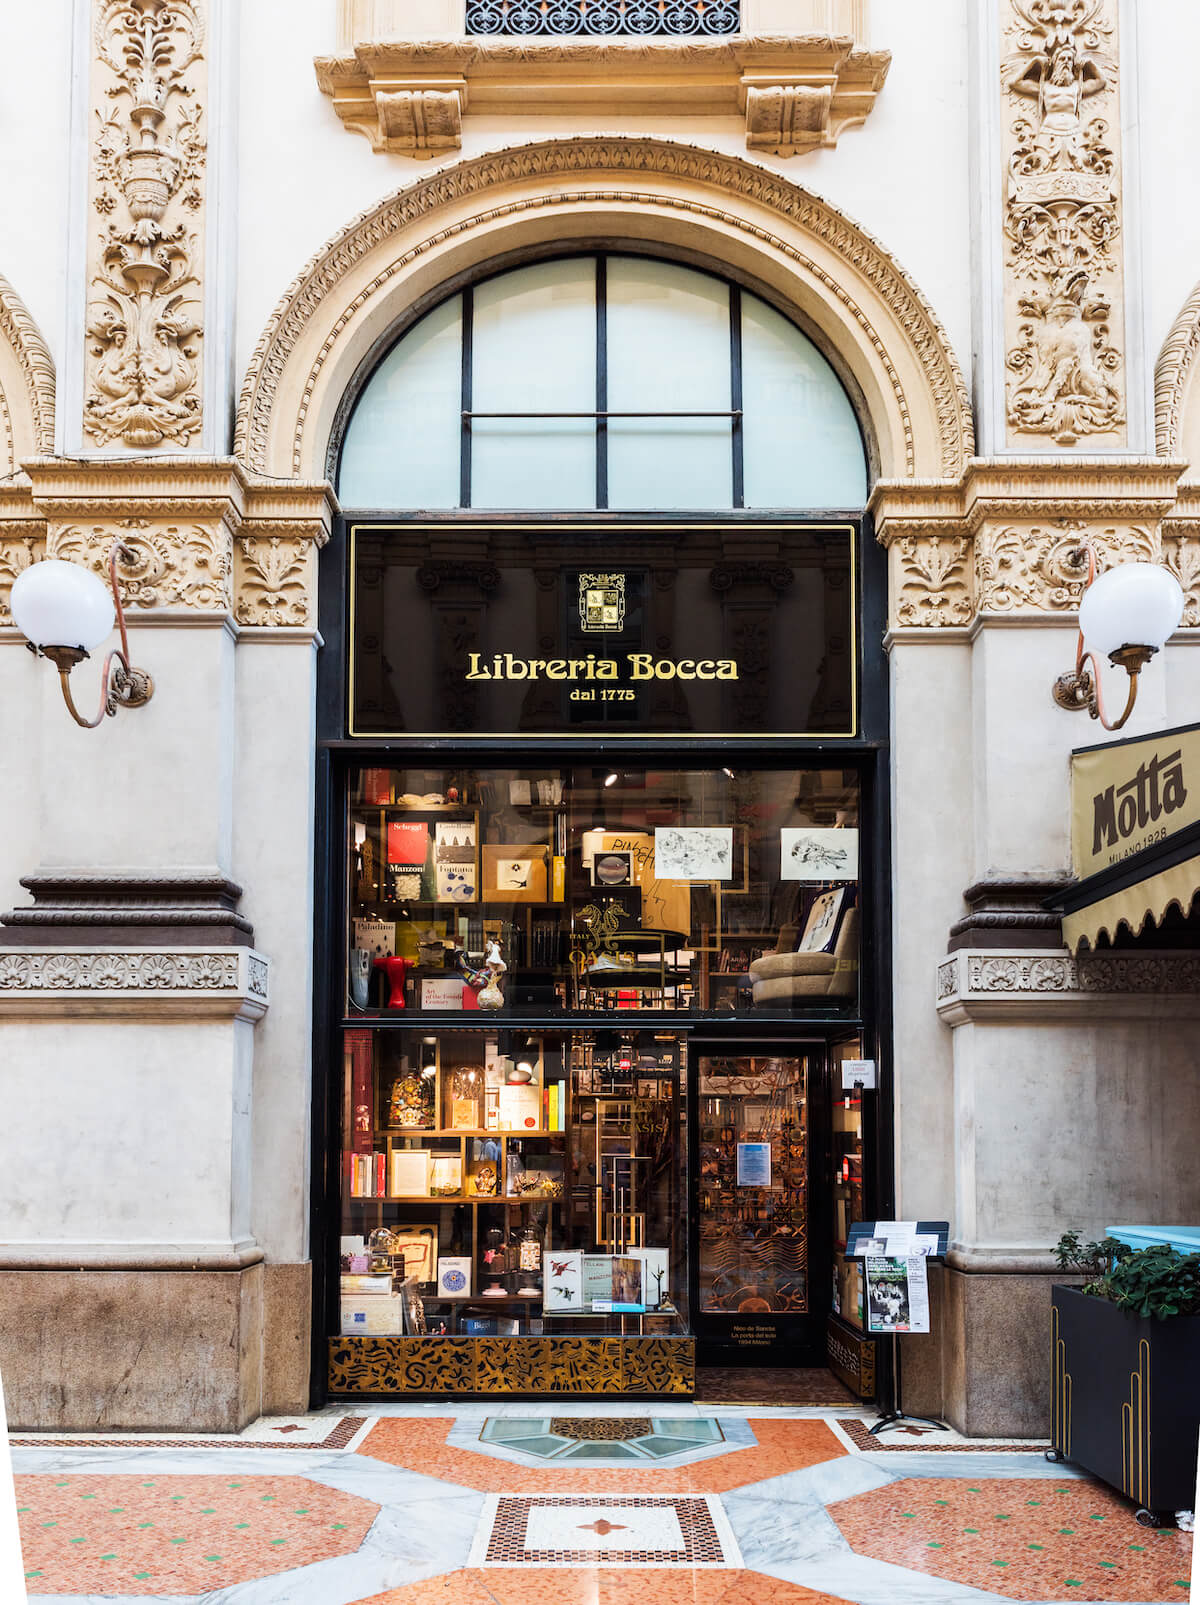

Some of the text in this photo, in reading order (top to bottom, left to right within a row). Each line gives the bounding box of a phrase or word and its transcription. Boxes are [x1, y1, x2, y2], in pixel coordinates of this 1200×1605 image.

[465, 653, 739, 680] Libreria Bocca
[570, 689, 636, 701] dal 1775
[1092, 749, 1187, 856] Motta
[1109, 826, 1167, 863] MILANO 1928
